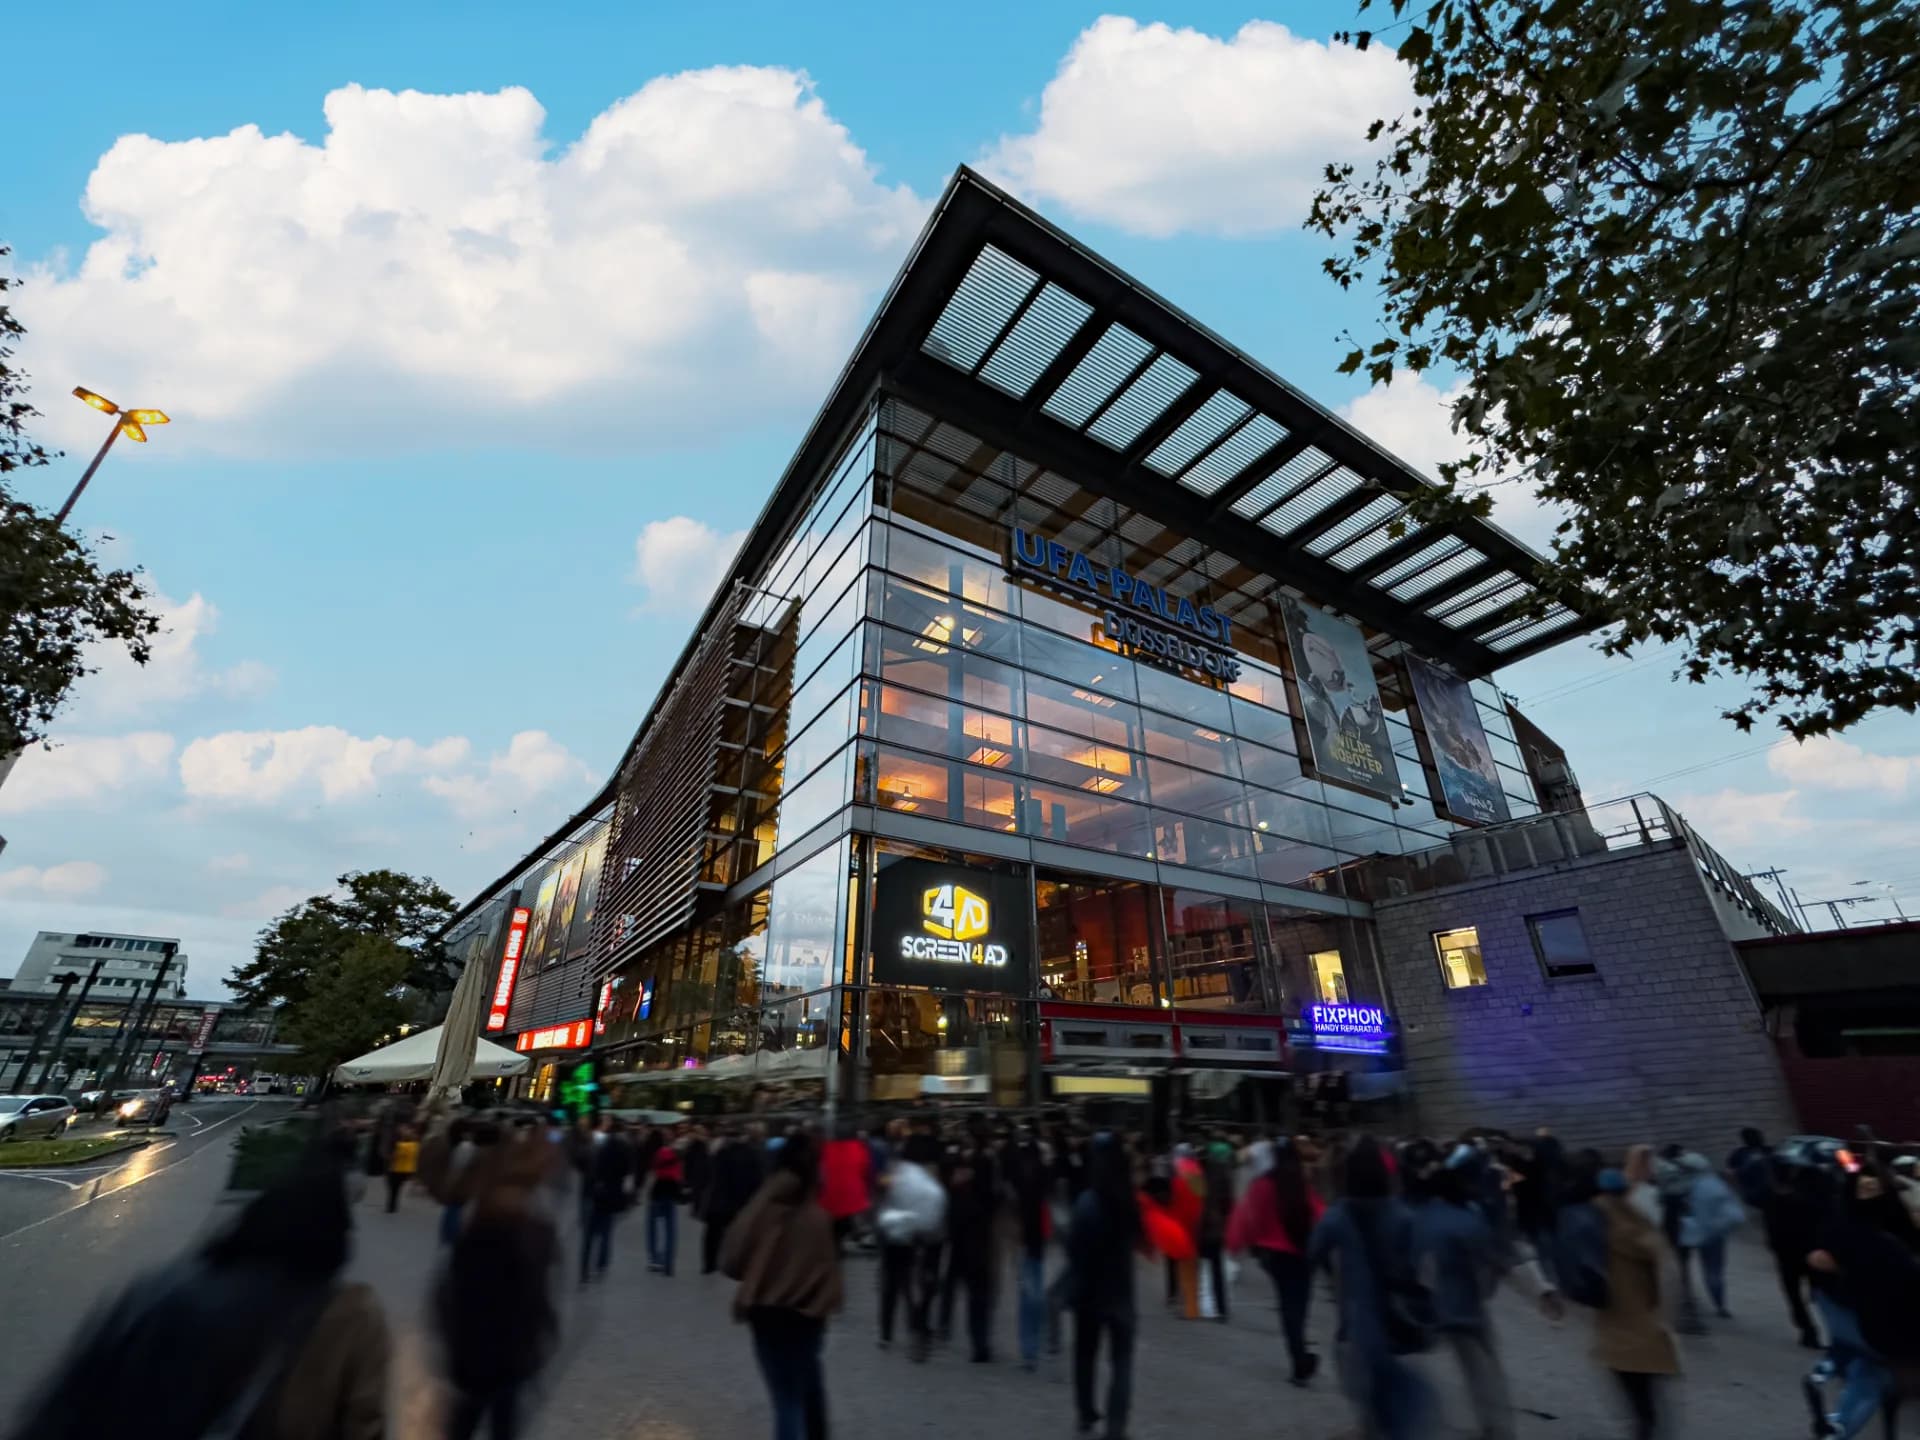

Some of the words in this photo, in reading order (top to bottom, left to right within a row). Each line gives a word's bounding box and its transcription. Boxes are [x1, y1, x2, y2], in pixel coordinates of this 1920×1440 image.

[1013, 527, 1232, 645] UFA-PALAST
[1103, 610, 1242, 683] DÜSSELDORF
[1312, 1006, 1383, 1025] FIXPHON
[1315, 1024, 1339, 1032] HANDY
[1340, 1025, 1383, 1033] REPARATUR
